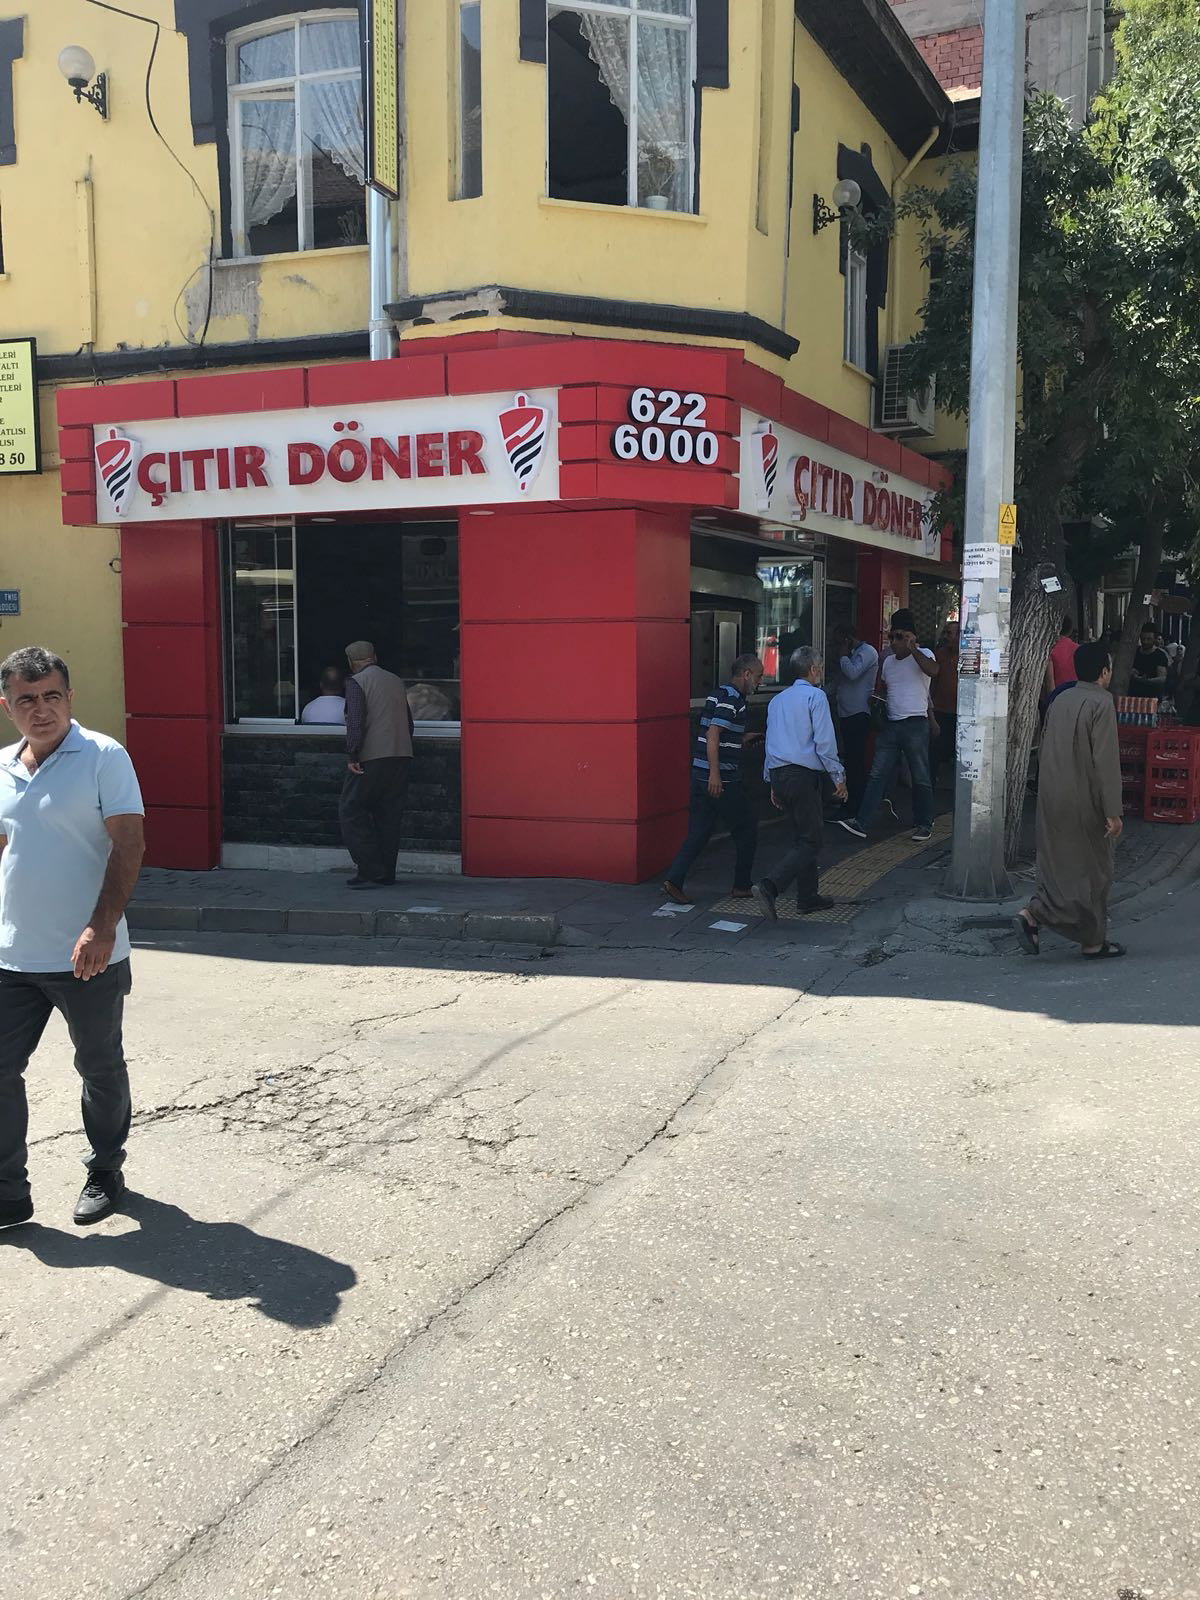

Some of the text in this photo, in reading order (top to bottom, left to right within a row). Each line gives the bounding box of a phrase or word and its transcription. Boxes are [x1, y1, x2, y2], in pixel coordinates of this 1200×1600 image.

[0, 350, 16, 359] ERİ
[629, 387, 707, 428] 622
[9, 452, 25, 465] 50
[137, 420, 487, 507] ÇITIR DÖNER
[613, 424, 719, 465] 6000
[793, 455, 922, 541] ÇITIR DÖNER
